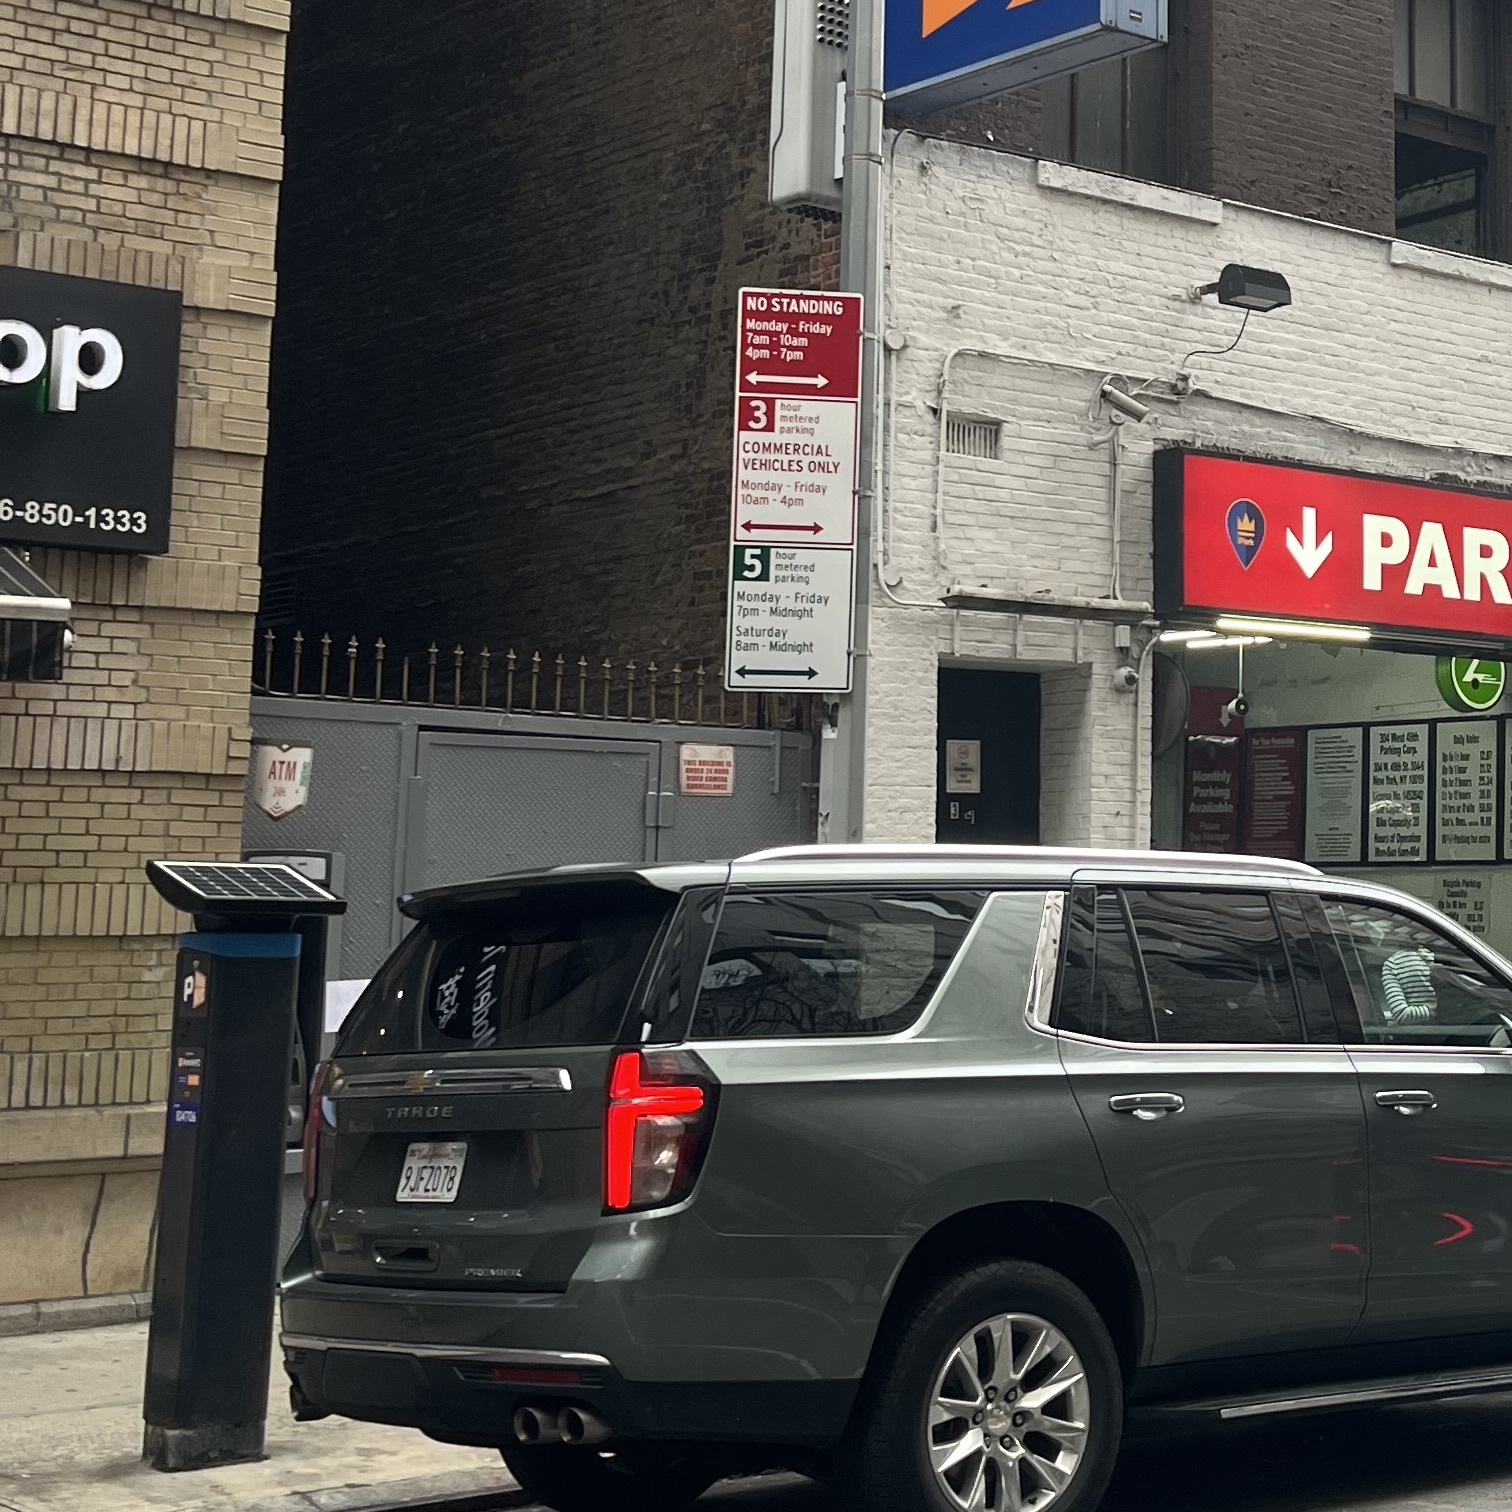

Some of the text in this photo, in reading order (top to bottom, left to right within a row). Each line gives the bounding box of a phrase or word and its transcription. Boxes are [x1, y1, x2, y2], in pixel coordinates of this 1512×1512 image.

[746, 296, 844, 315] NO STANDING
[745, 318, 789, 333] Monday
[798, 320, 833, 336] Friday
[745, 332, 770, 345] 7am
[780, 334, 809, 347] 10am
[745, 346, 770, 360] 4pm
[780, 348, 804, 362] 7pm
[748, 399, 768, 430] 3
[780, 402, 803, 412] hour
[780, 414, 820, 425] metered
[779, 426, 815, 437] parking
[742, 441, 832, 457] COMMERCIAL
[742, 458, 841, 474] VEHICLES ONLY
[740, 479, 783, 493] Monday
[794, 481, 828, 496] Friday
[740, 494, 769, 506] 10am
[780, 495, 804, 508] 4pm
[0, 498, 148, 534] 6-850-1333
[775, 550, 797, 560] hour
[742, 548, 762, 578] 5
[774, 563, 815, 573] metered
[774, 574, 810, 585] parking
[736, 590, 781, 605] Monday
[794, 592, 830, 607] Friday
[736, 605, 760, 618] 7pm
[769, 606, 814, 620] Midnight
[735, 625, 788, 640] Saturday
[734, 640, 759, 652] 8am
[769, 641, 814, 655] Midnight
[267, 759, 297, 781] ATM
[1192, 769, 1232, 785] Monthly
[1192, 786, 1231, 800] Parking
[1188, 801, 1234, 814] Available
[385, 1106, 454, 1119] TAHOE
